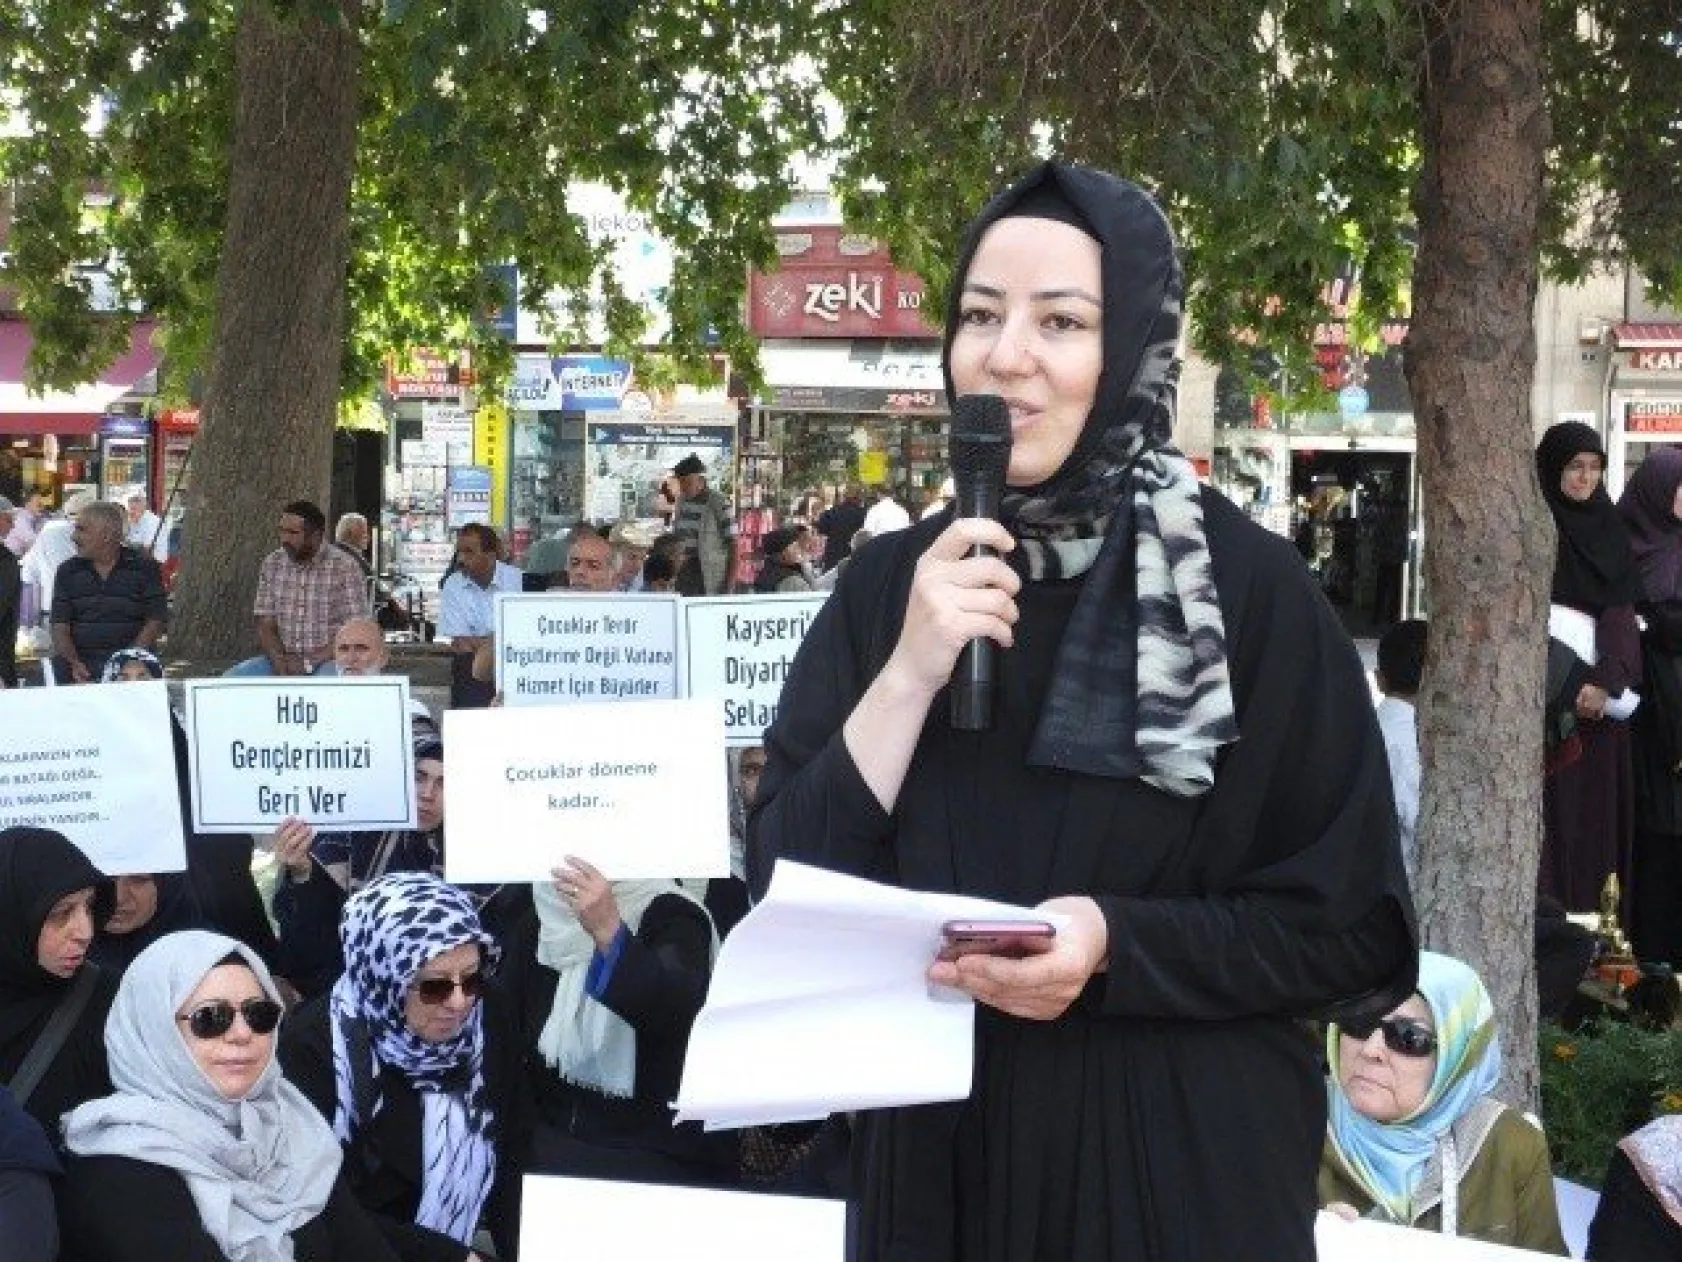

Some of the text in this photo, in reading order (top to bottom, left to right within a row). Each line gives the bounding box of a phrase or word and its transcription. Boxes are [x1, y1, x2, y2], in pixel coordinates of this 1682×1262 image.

[537, 614, 599, 636] Çocuklar
[584, 646, 621, 668] Değil
[624, 646, 673, 664] Vatana
[516, 673, 660, 698] Hizmet İçin Büyürler
[276, 696, 318, 731] Hdp
[231, 740, 371, 776] Gençlerimizi
[505, 762, 658, 785] Çocuklar dönene
[258, 785, 347, 815] Geri Ver
[547, 792, 616, 808] kadar...
